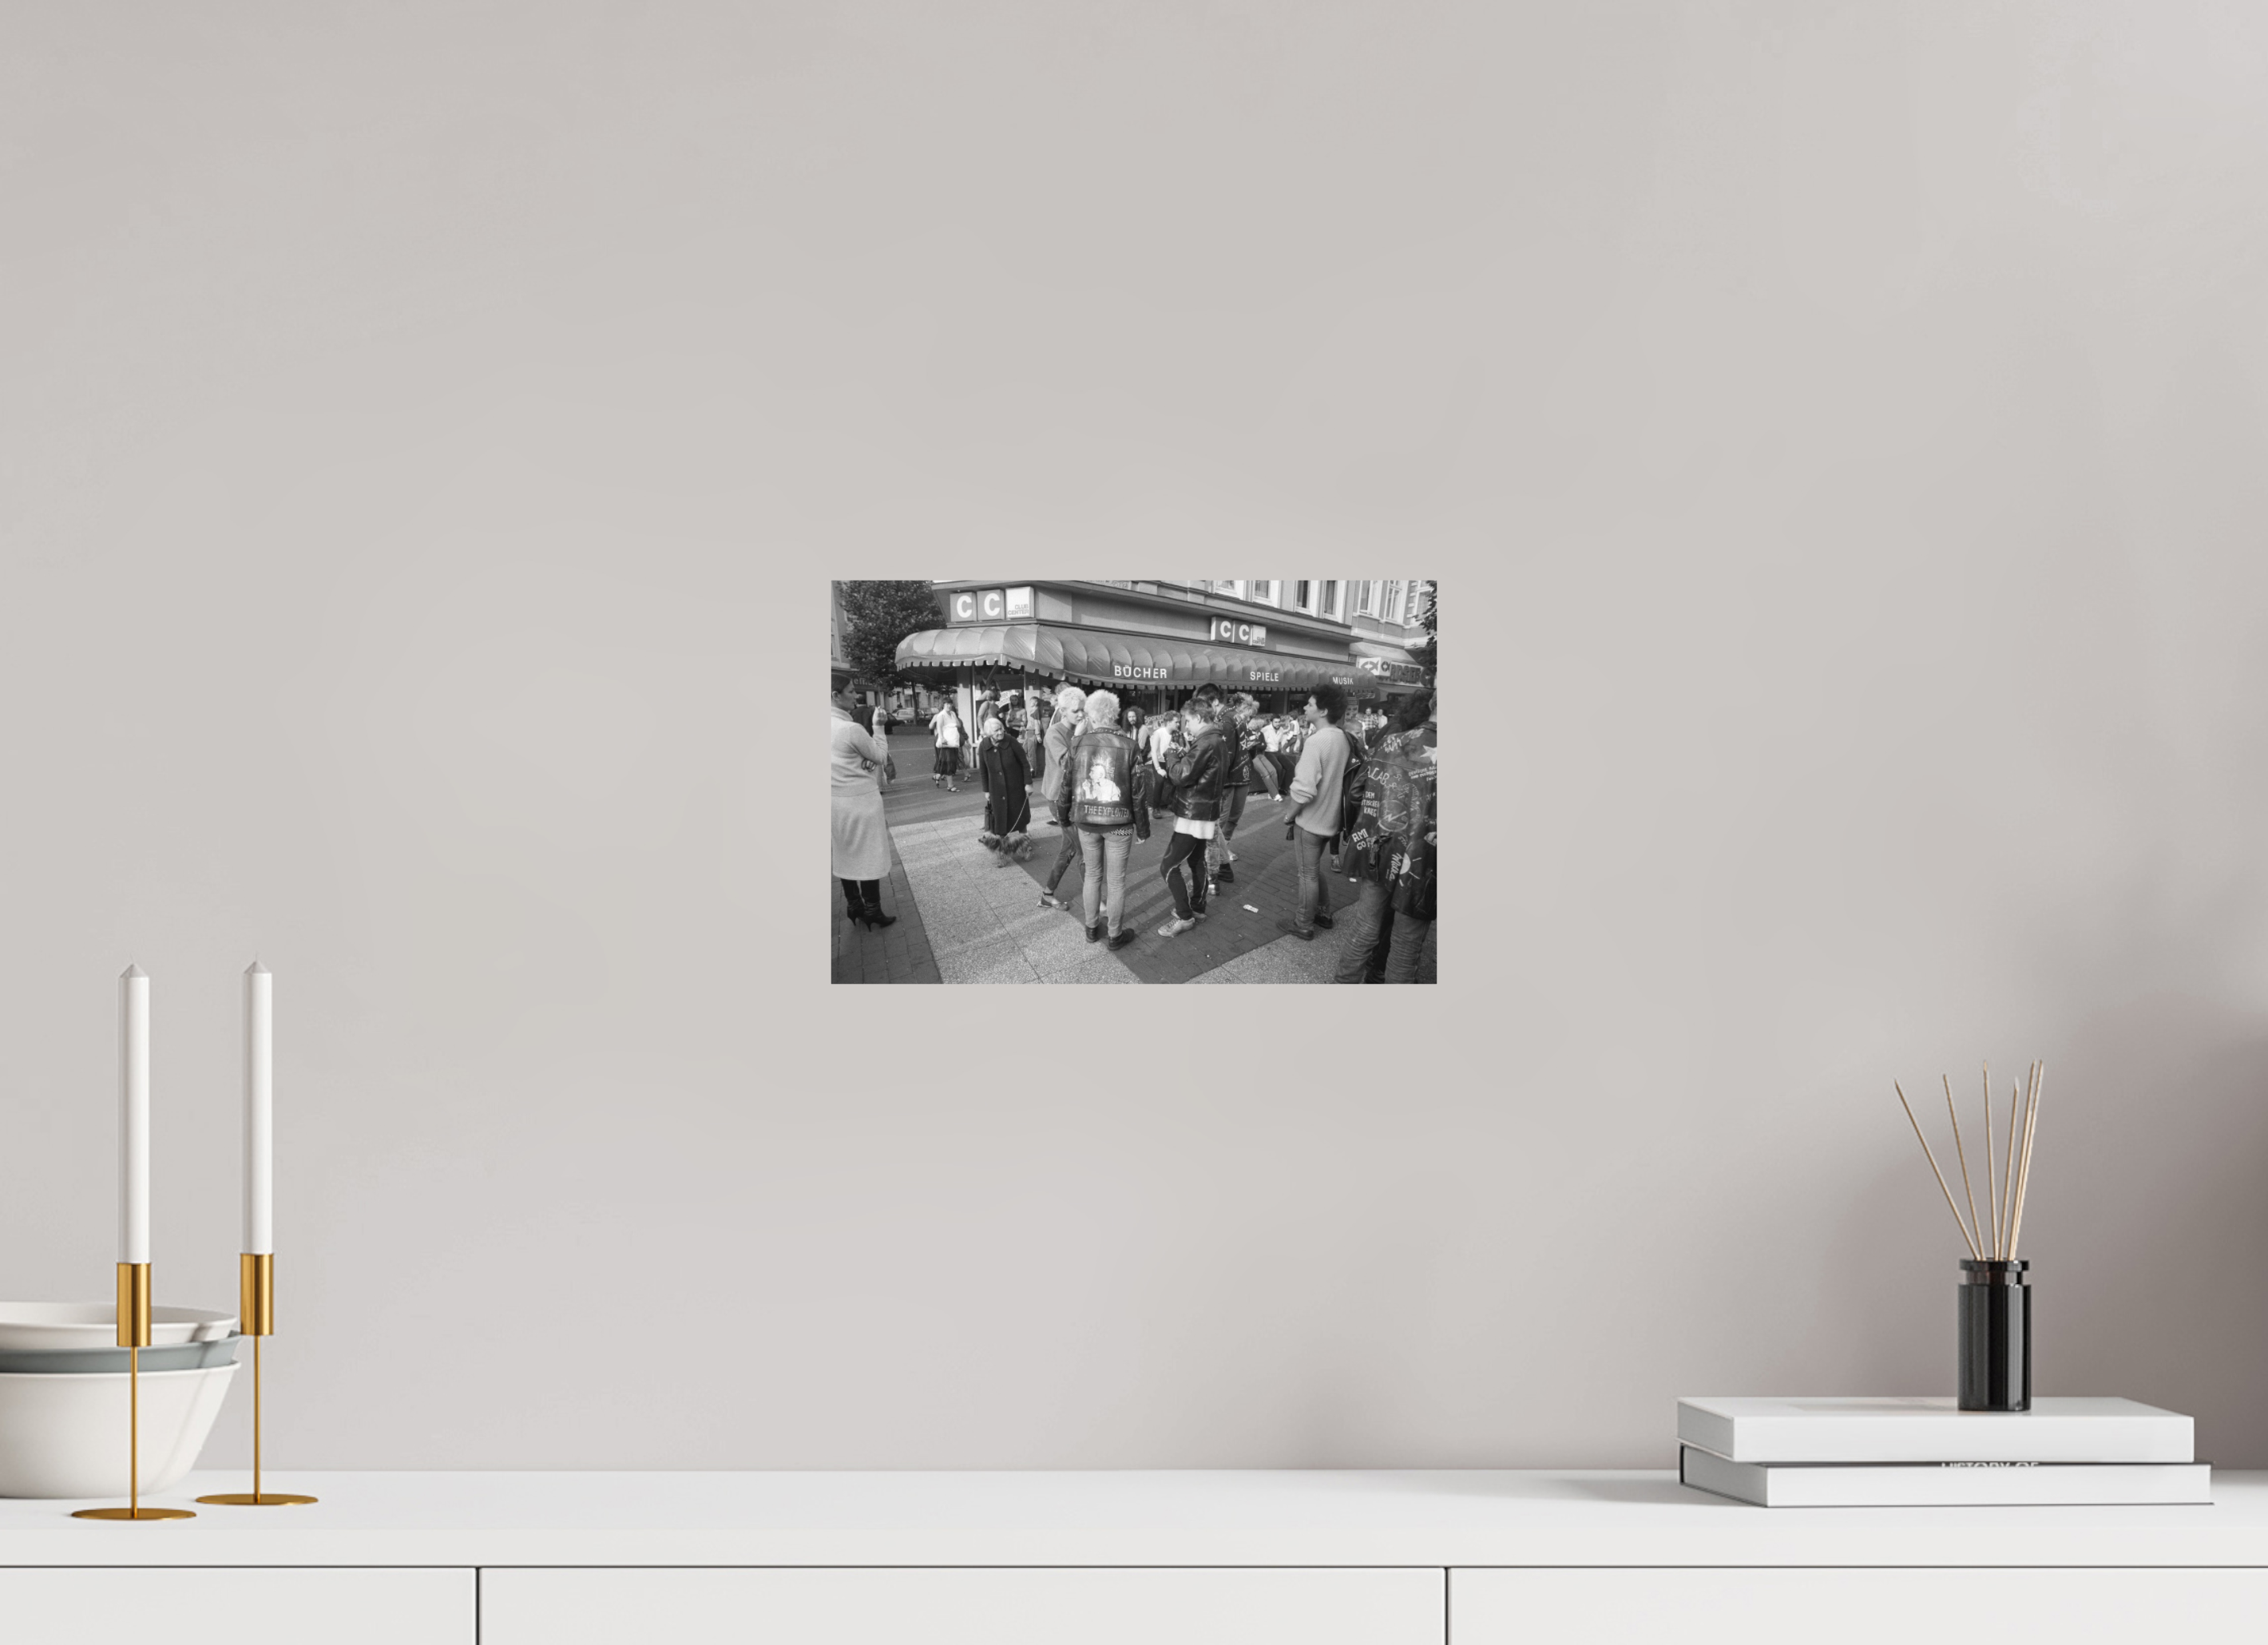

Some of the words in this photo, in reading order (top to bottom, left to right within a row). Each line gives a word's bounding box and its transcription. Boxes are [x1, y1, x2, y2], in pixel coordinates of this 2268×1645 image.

[1114, 664, 1168, 679] BÜCHER
[1250, 671, 1279, 682] SPIELE
[1332, 676, 1354, 685] MUSIK
[1351, 828, 1369, 842] AMI
